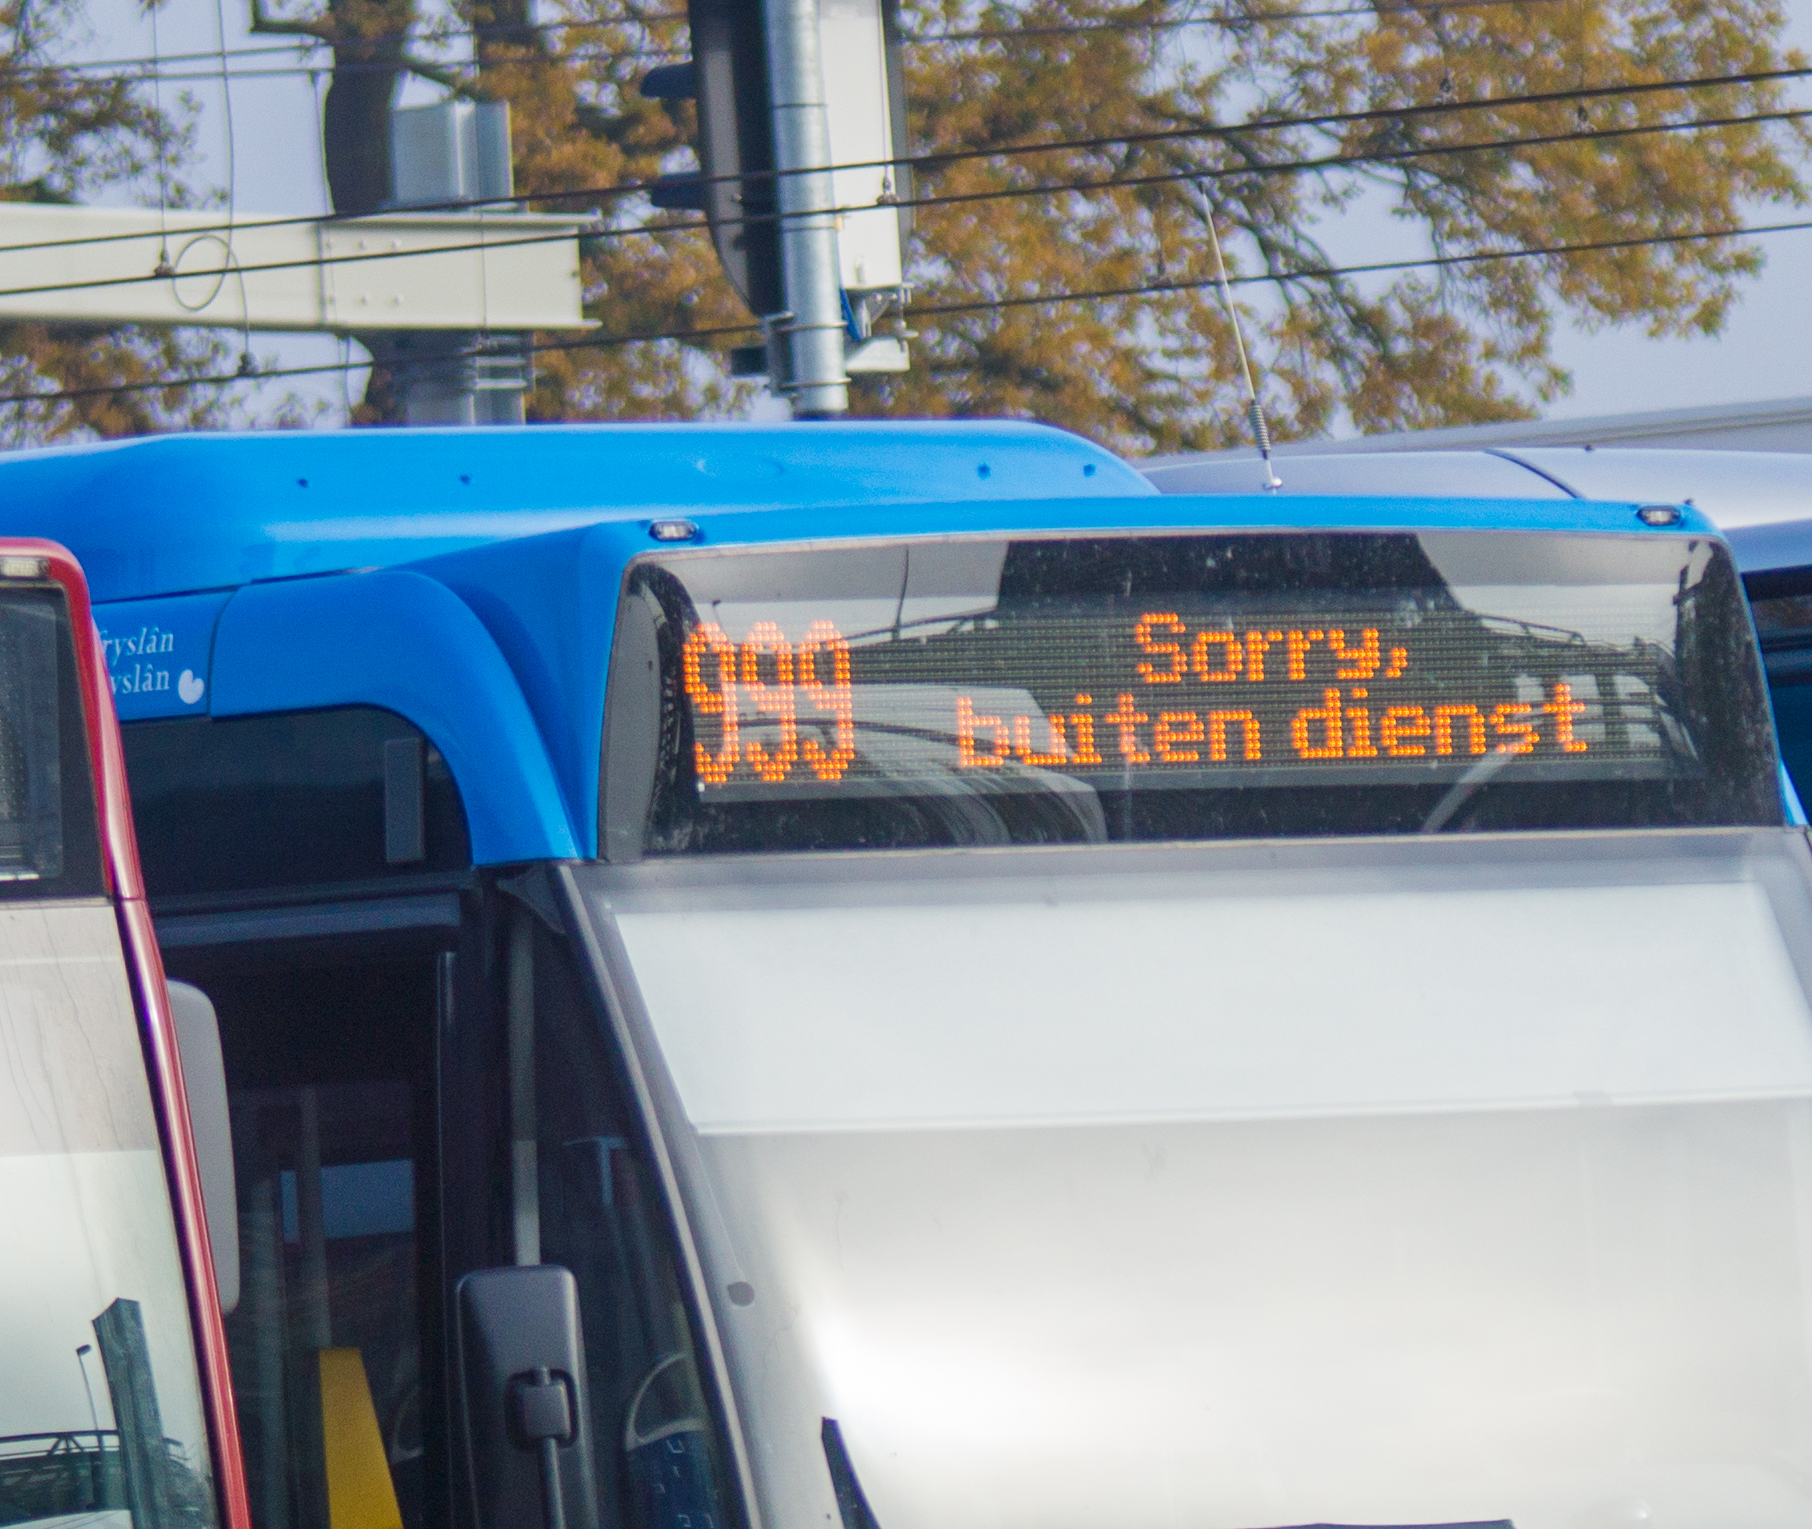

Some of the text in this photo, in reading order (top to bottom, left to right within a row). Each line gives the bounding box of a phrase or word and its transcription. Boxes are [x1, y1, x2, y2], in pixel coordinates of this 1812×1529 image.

[1132, 611, 1410, 684] Sorry,
[681, 620, 857, 785] 999
[957, 682, 1589, 768] buiten dienst
